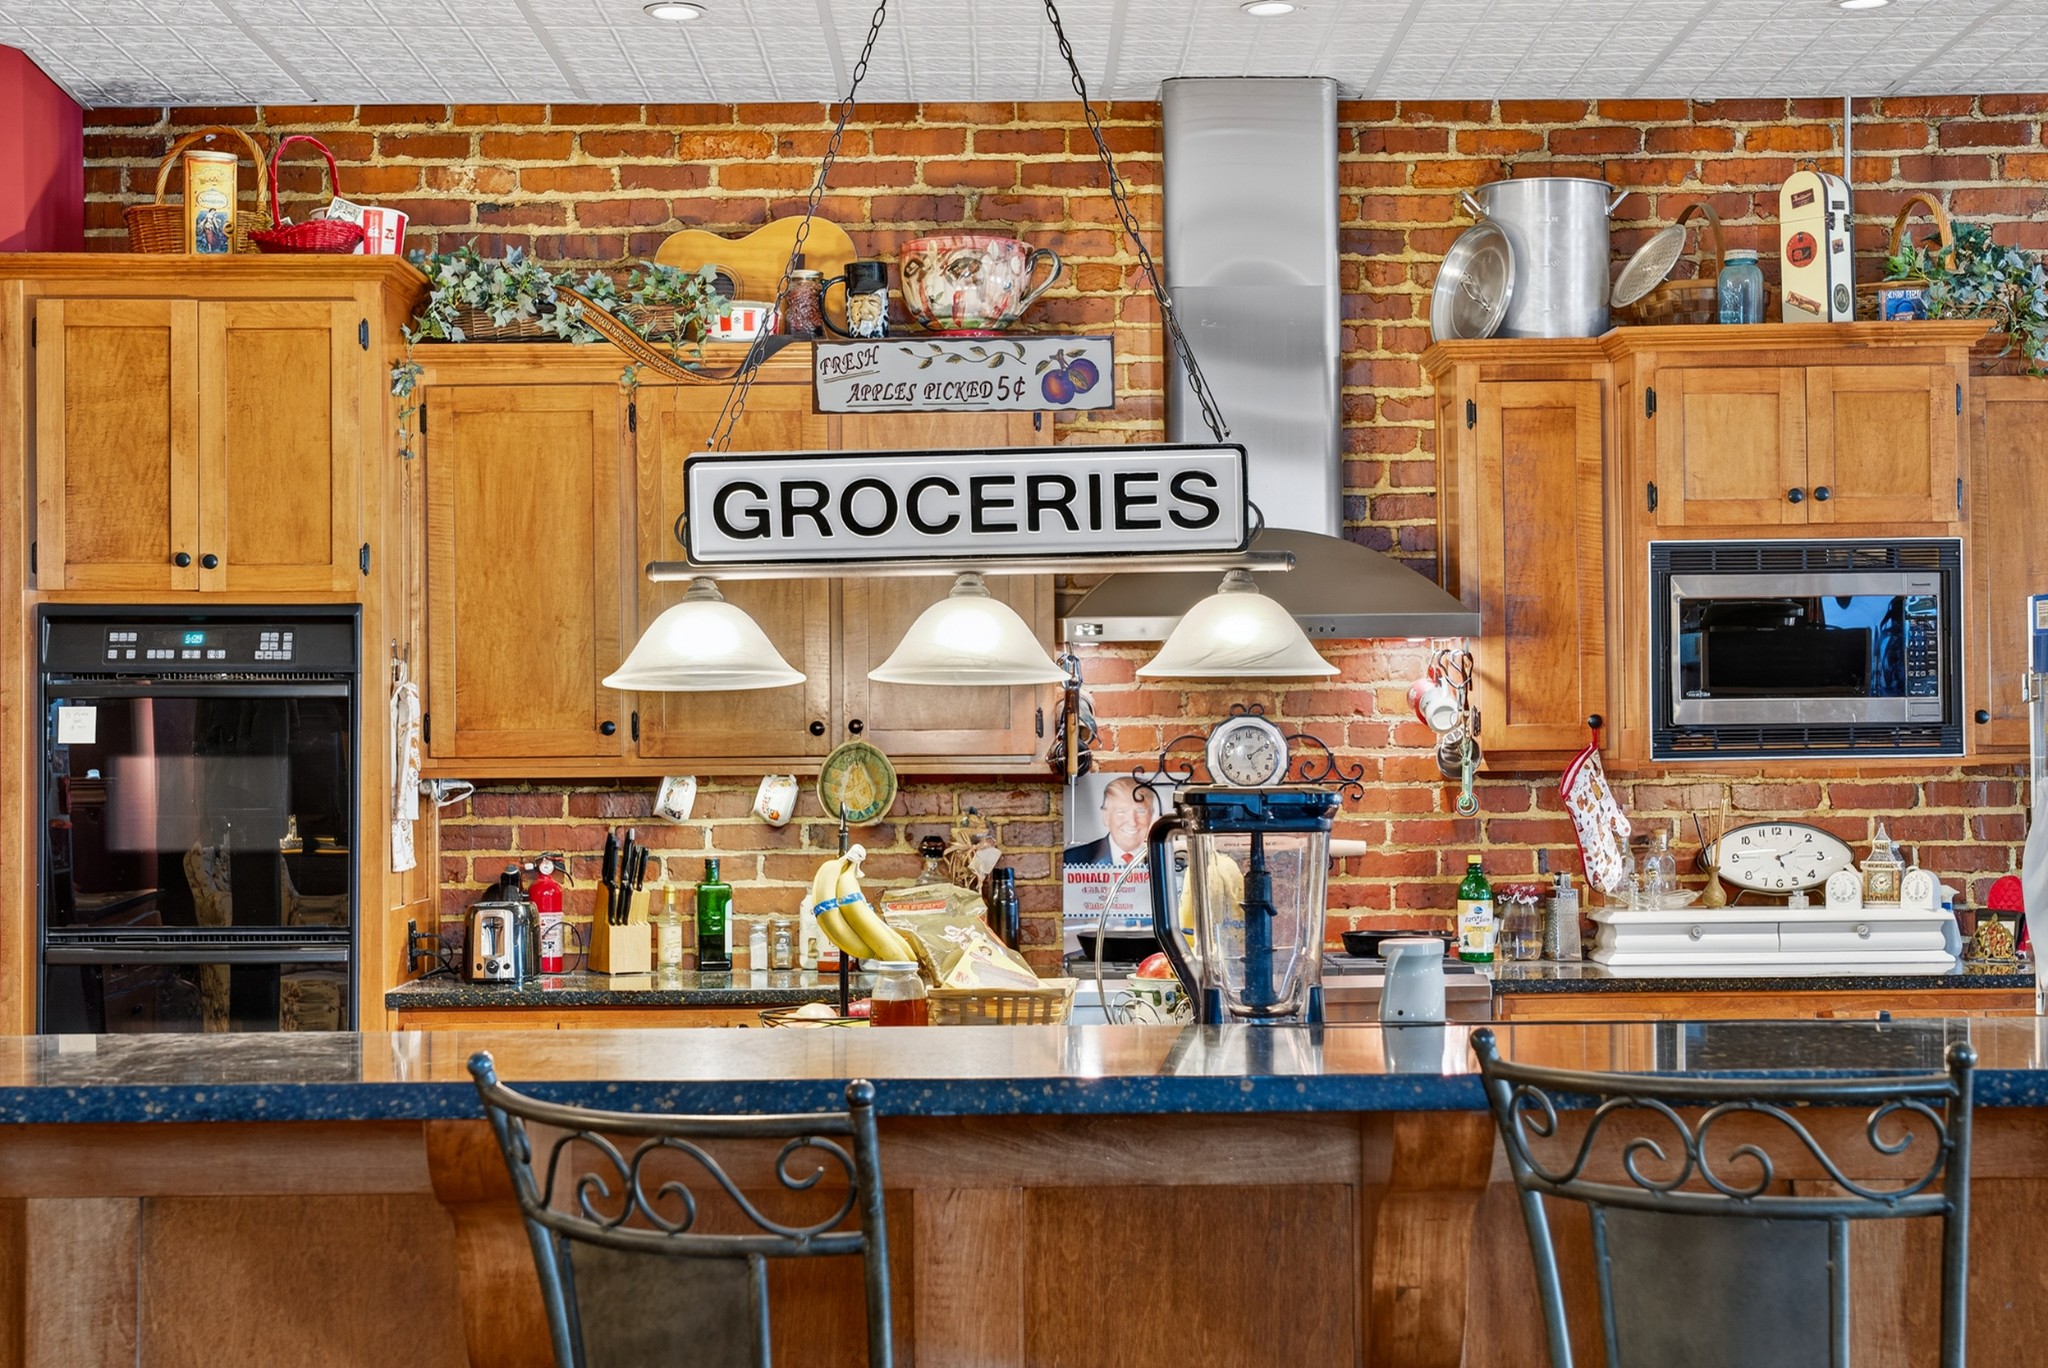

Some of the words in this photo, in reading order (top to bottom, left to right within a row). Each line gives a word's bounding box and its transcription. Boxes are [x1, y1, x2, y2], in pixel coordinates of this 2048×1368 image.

[819, 345, 880, 375] FRESH
[846, 382, 918, 403] APPLES
[922, 380, 994, 402] PICKED
[996, 376, 1027, 401] 5¢
[712, 470, 1221, 540] GROCERIES
[1758, 829, 1766, 838] 11
[1771, 827, 1782, 836] 12
[1789, 828, 1793, 837] 1
[1741, 836, 1751, 845] 10
[1804, 834, 1813, 843] 2
[1816, 851, 1825, 861] 3
[1067, 872, 1111, 884] DONALD
[1113, 872, 1151, 884] TUMP
[1744, 870, 1753, 880] 8
[1807, 869, 1816, 879] 4
[1761, 877, 1769, 887] 7
[1775, 879, 1784, 888] 6
[1791, 877, 1799, 886] 5
